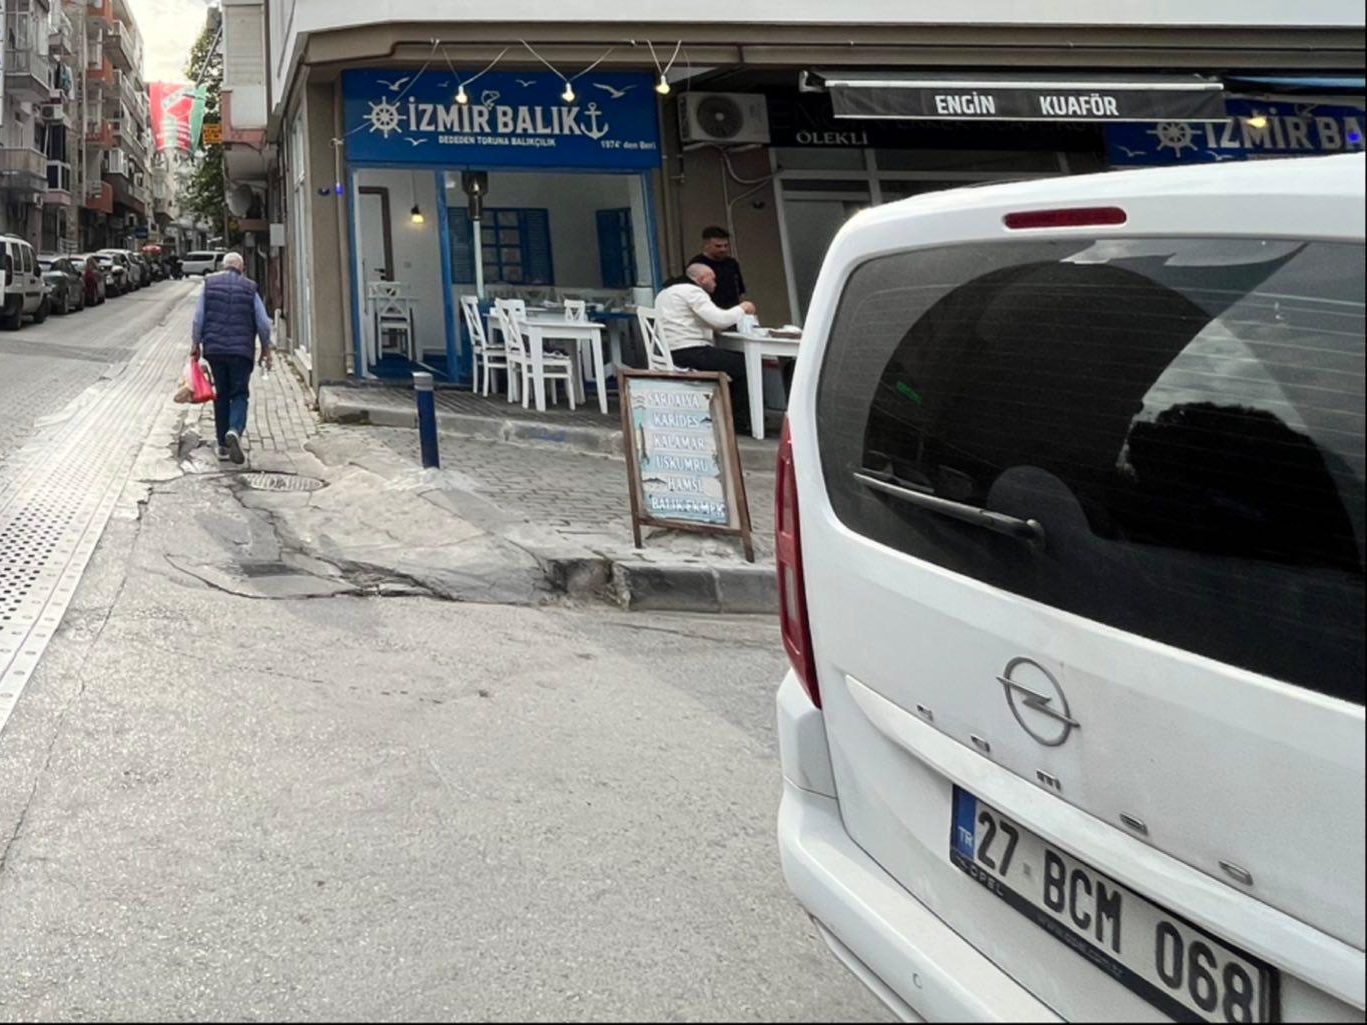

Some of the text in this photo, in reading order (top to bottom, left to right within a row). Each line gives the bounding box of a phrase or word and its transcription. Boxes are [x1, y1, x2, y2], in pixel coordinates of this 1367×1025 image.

[935, 91, 1119, 116] ENGİN KUAFÖR
[409, 96, 584, 135] İZMİR BALIK
[438, 135, 475, 144] DEDEDEN
[477, 136, 509, 145] TORUNA
[653, 434, 705, 449] KALAMAR
[958, 826, 974, 848] TR
[977, 811, 1019, 877] 27
[1044, 849, 1122, 954] BCM
[1155, 920, 1254, 1023] 068
